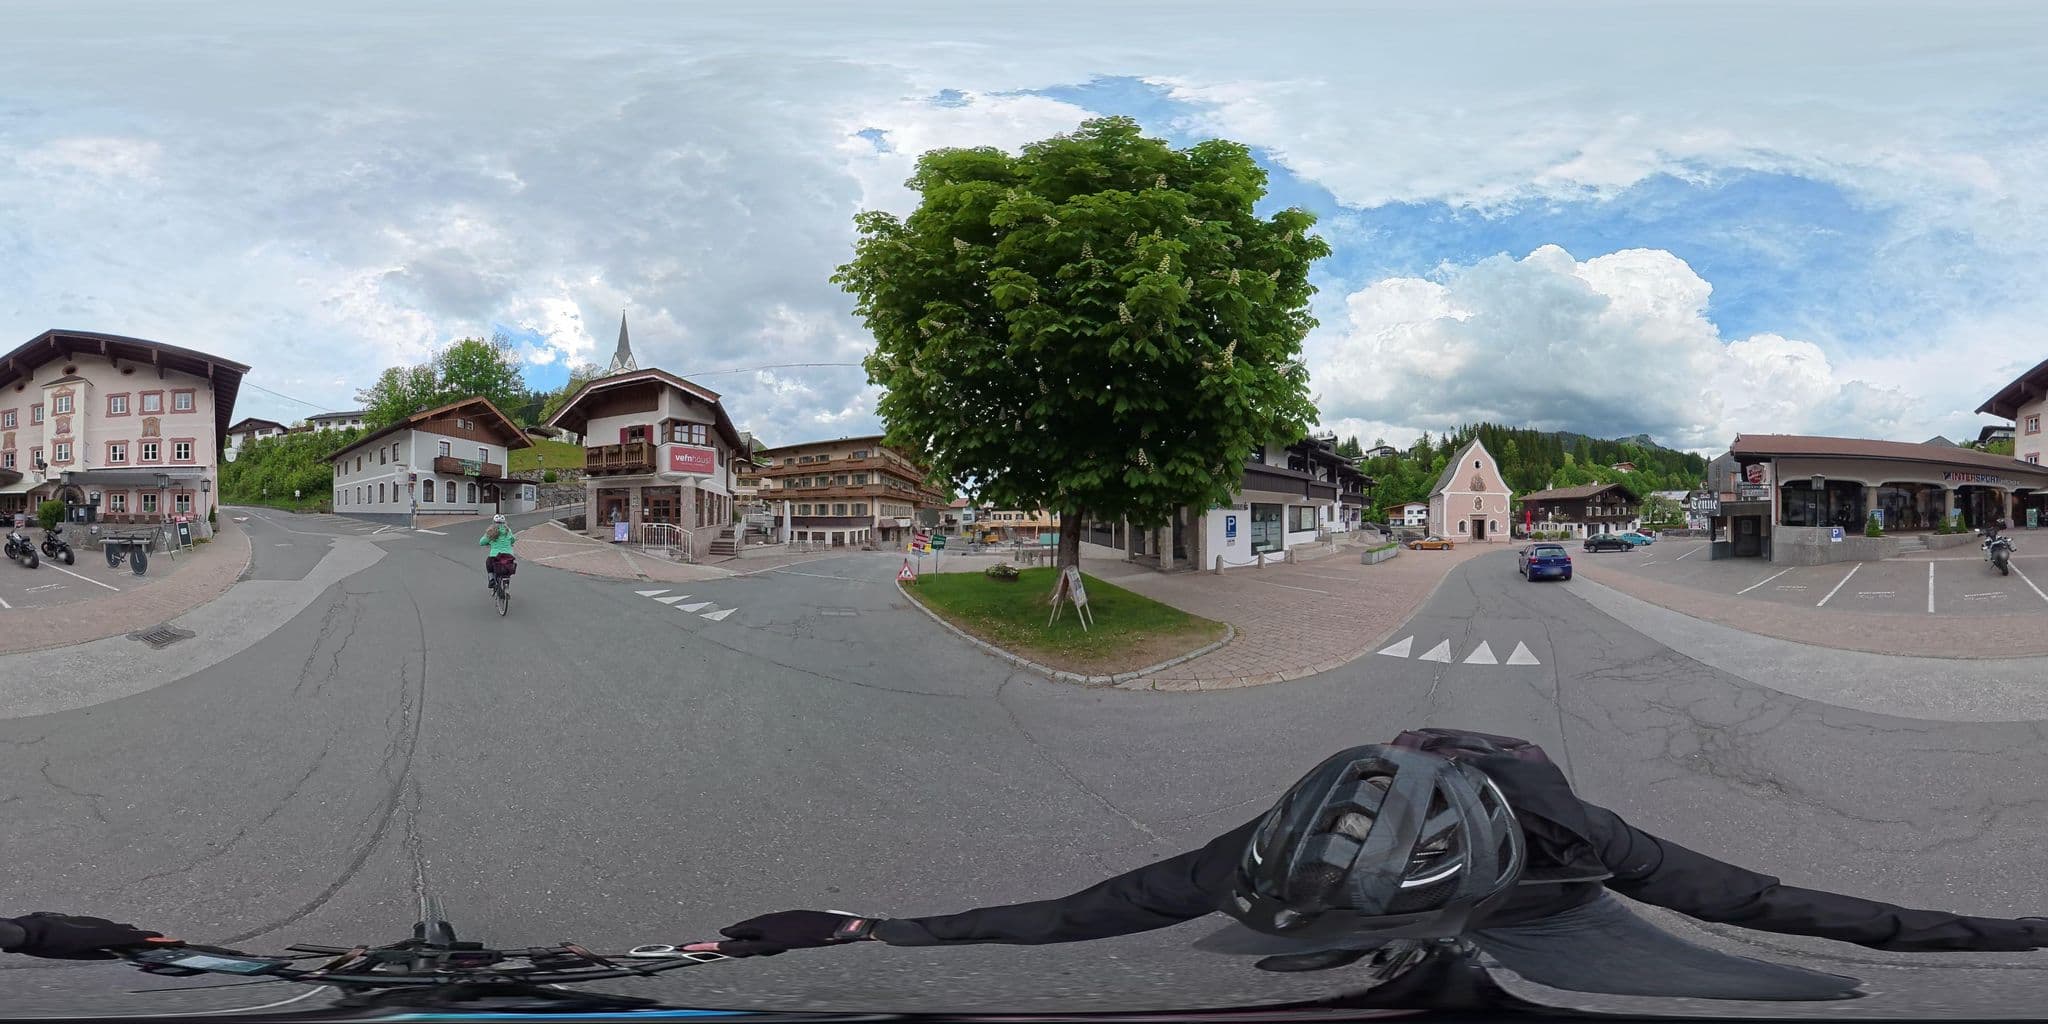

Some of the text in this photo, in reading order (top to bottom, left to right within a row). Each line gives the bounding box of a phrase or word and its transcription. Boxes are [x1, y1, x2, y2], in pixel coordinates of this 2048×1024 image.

[1952, 472, 2000, 484] INTERSPORT
[1691, 497, 1717, 510] Tenne
[1228, 517, 1235, 531] P
[1832, 528, 1839, 537] P
